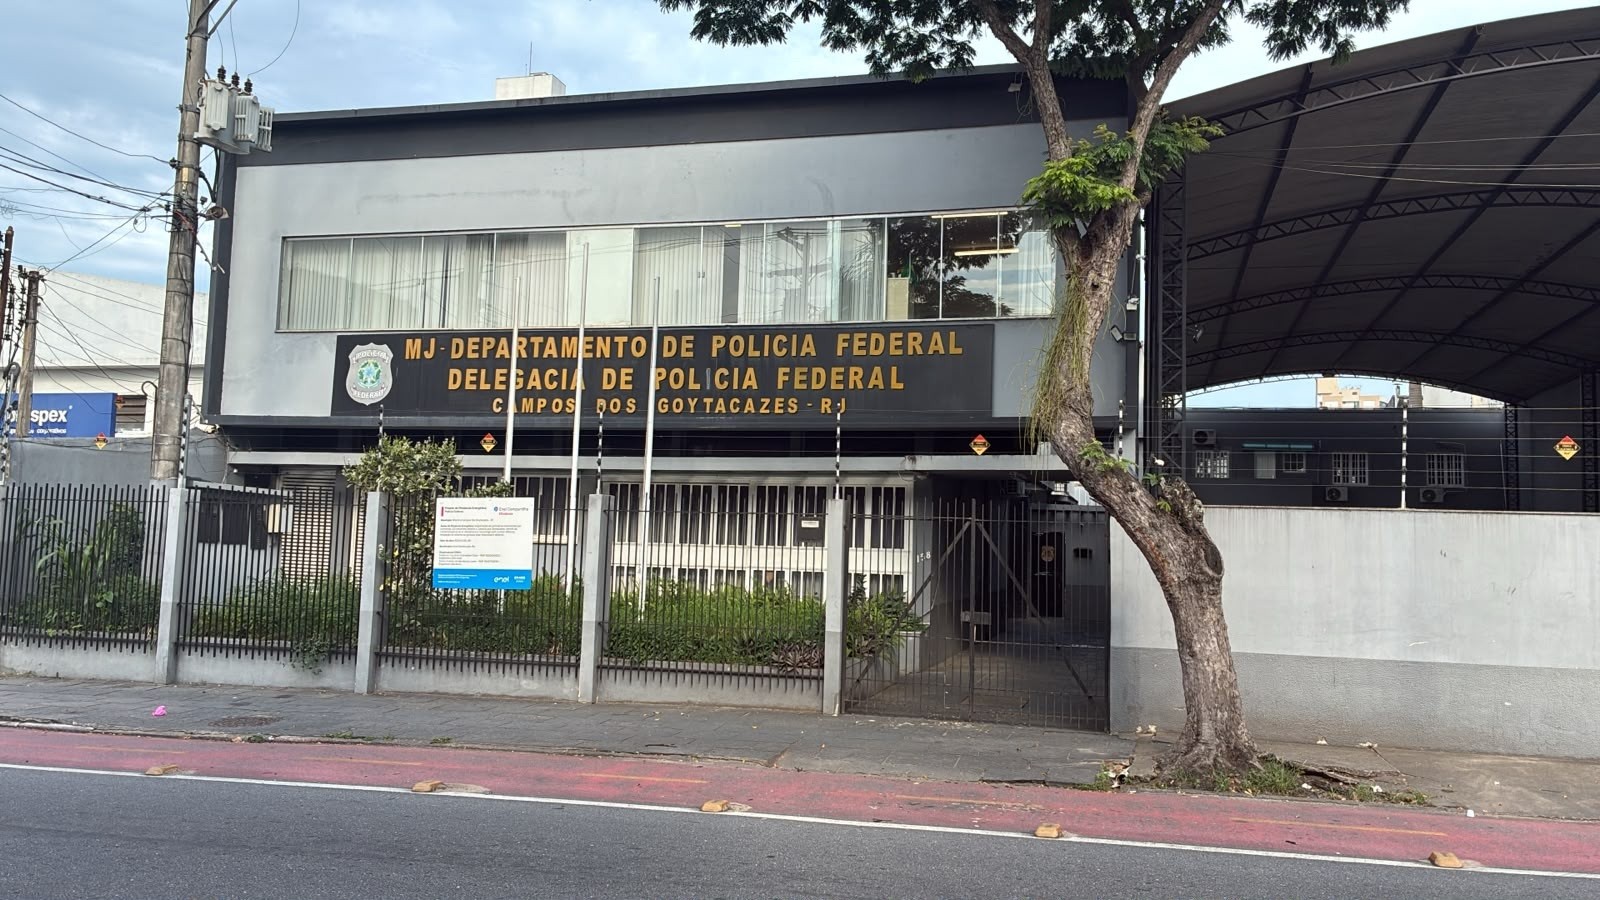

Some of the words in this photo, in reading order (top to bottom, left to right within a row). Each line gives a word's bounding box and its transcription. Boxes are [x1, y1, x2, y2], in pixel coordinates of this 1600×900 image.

[663, 335, 695, 358] DE
[711, 334, 817, 358] POLICIA
[836, 331, 963, 356] FEDERAL
[447, 368, 586, 390] DELEGACIA
[602, 368, 634, 390] DE
[777, 366, 905, 390] FEDERAL
[596, 397, 637, 413] DOS
